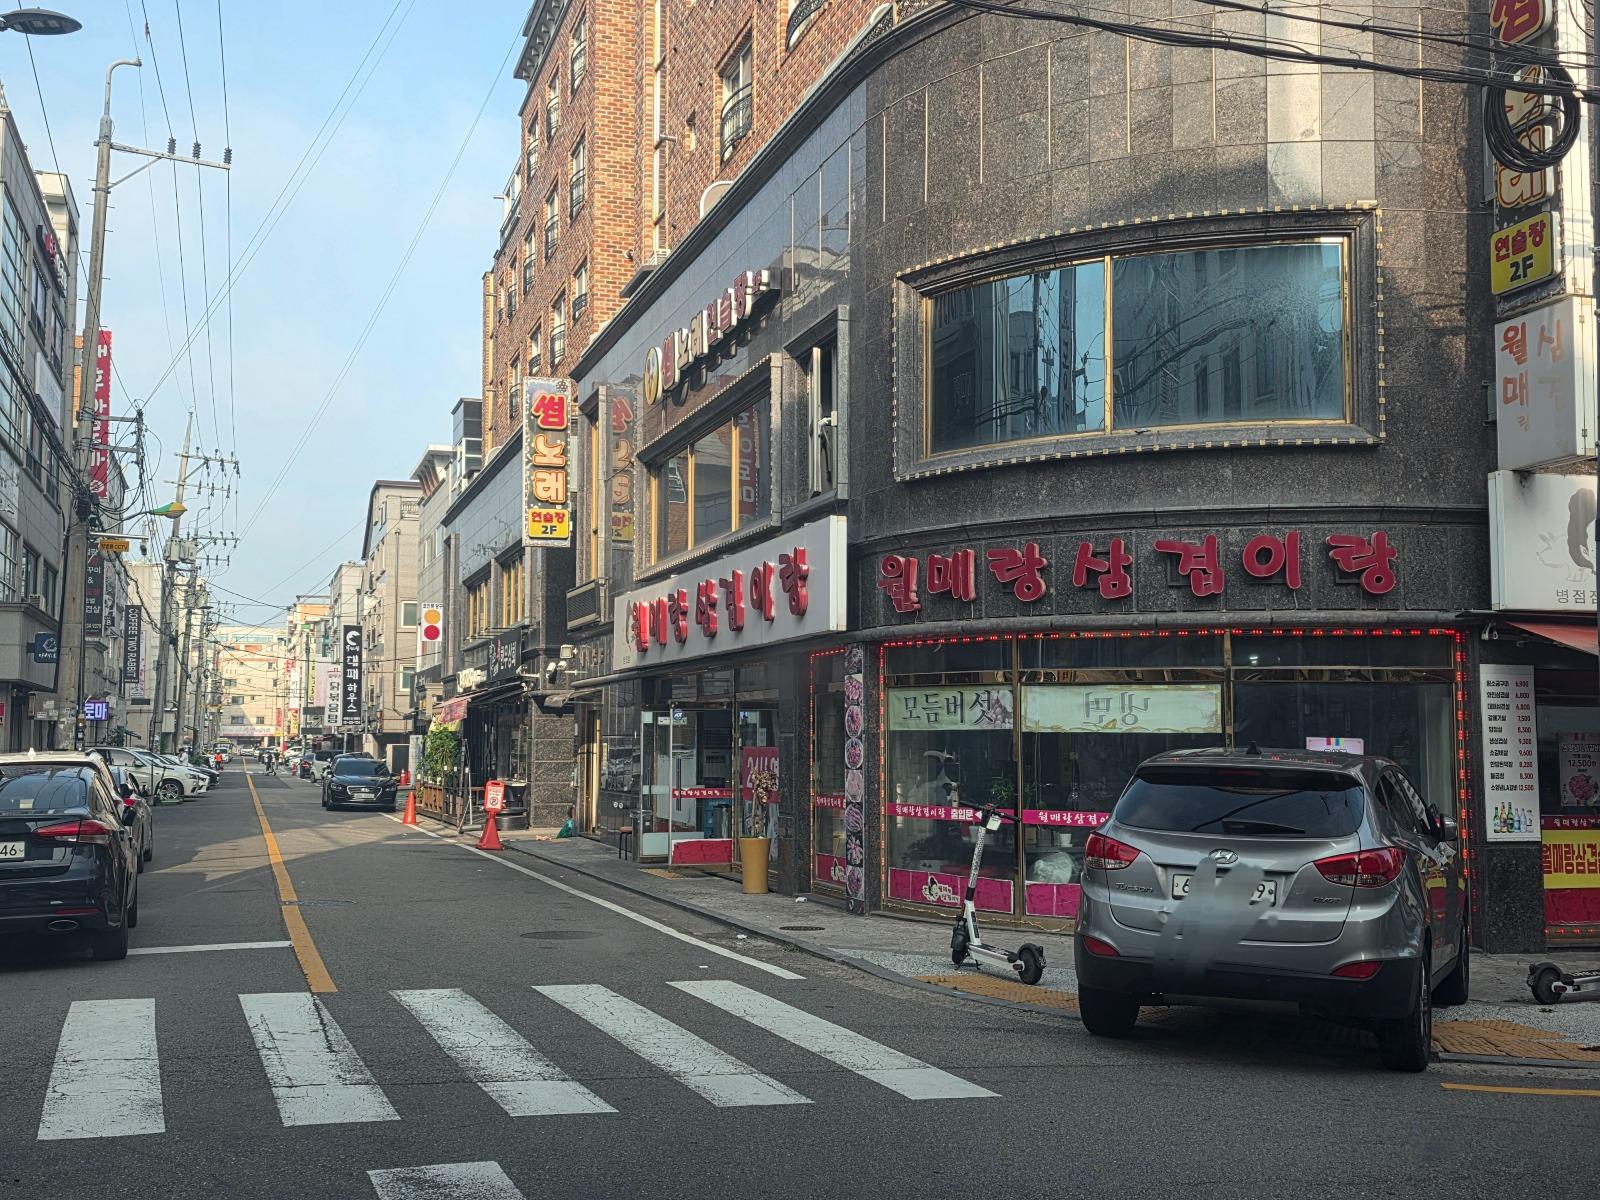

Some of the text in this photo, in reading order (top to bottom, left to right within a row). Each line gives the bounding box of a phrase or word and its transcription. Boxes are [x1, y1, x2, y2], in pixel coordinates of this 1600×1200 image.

[1494, 220, 1546, 262] 연습장
[1510, 254, 1533, 282] 2F
[531, 394, 568, 504] 썸노래
[531, 511, 565, 524] 연습장
[541, 525, 557, 535] 2F
[128, 608, 138, 634] COFFEE
[127, 635, 138, 652] TWO
[127, 652, 137, 678] RABBIT
[902, 690, 995, 725] 모듬버섯
[950, 808, 974, 820] 출입문
[1543, 843, 1600, 875] 월매랑삼겹
